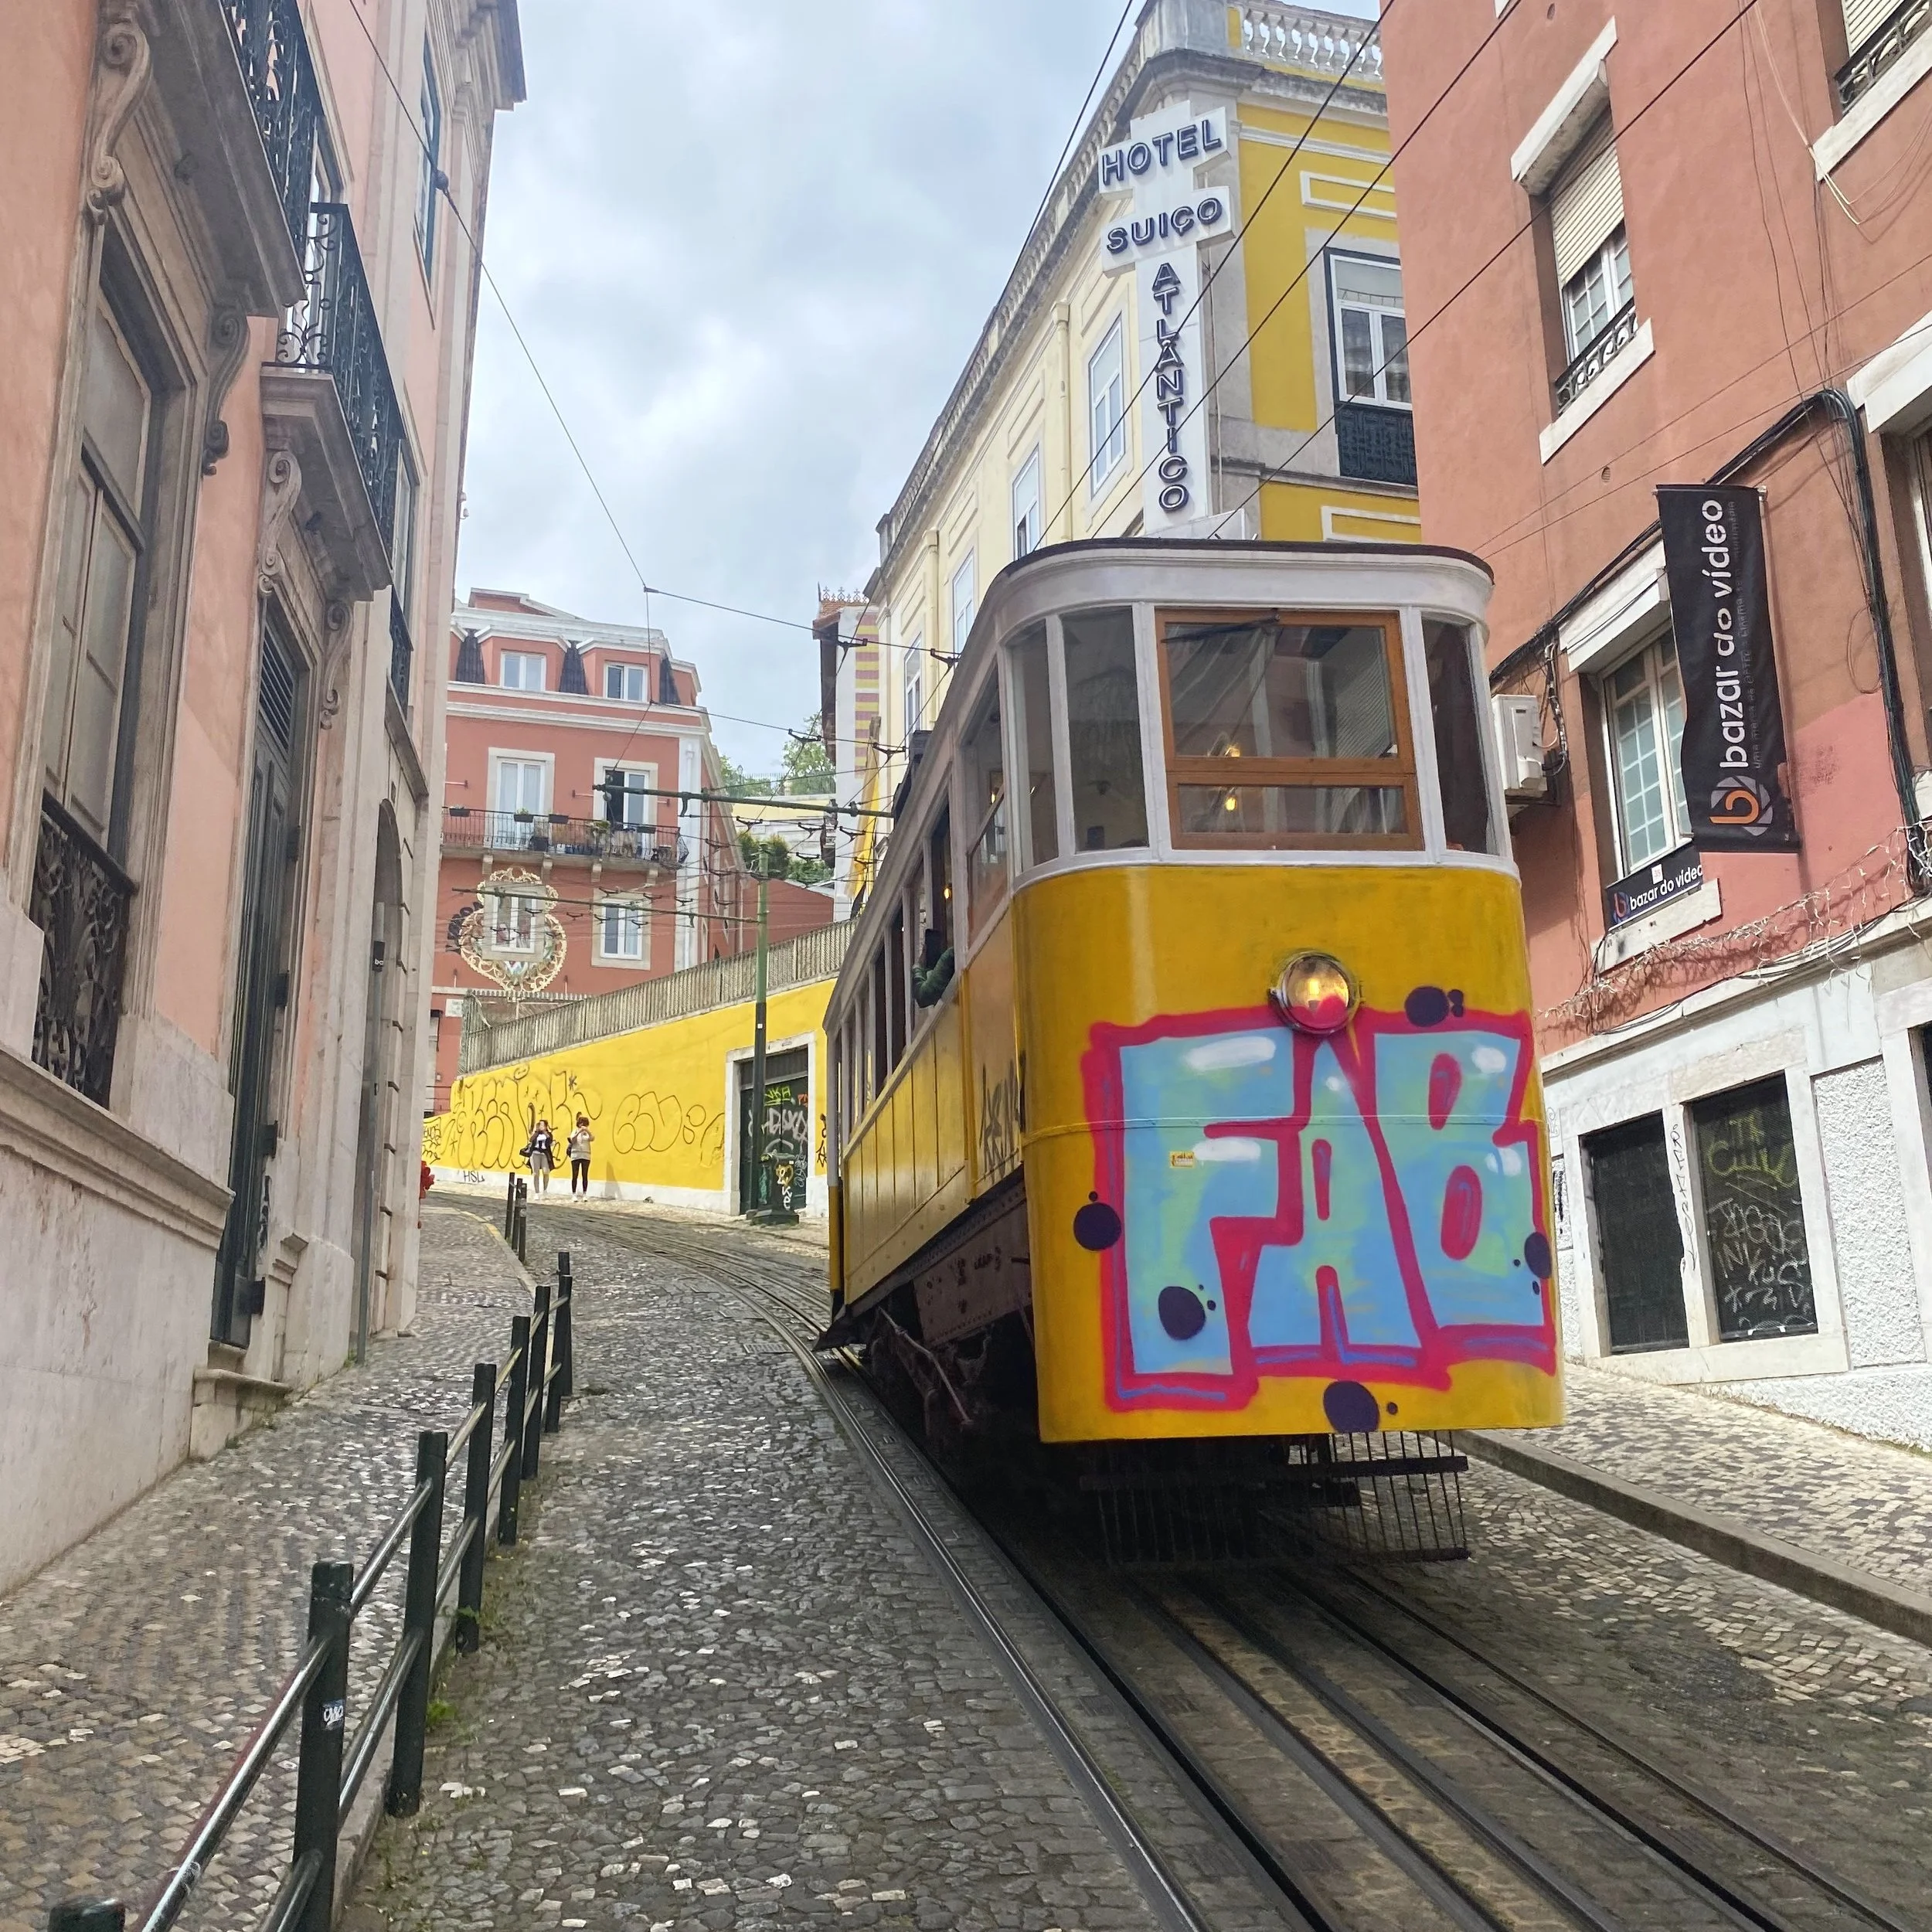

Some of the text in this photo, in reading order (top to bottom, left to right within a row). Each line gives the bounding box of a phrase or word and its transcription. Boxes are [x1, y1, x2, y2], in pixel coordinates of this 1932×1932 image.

[1102, 119, 1222, 185] HOTEL
[1107, 197, 1223, 254] SUIÇO
[1701, 499, 1749, 768] bazar do vídeo
[1630, 887, 1658, 910] bazar
[1659, 879, 1675, 896] do
[1082, 1008, 1555, 1411] FAB
